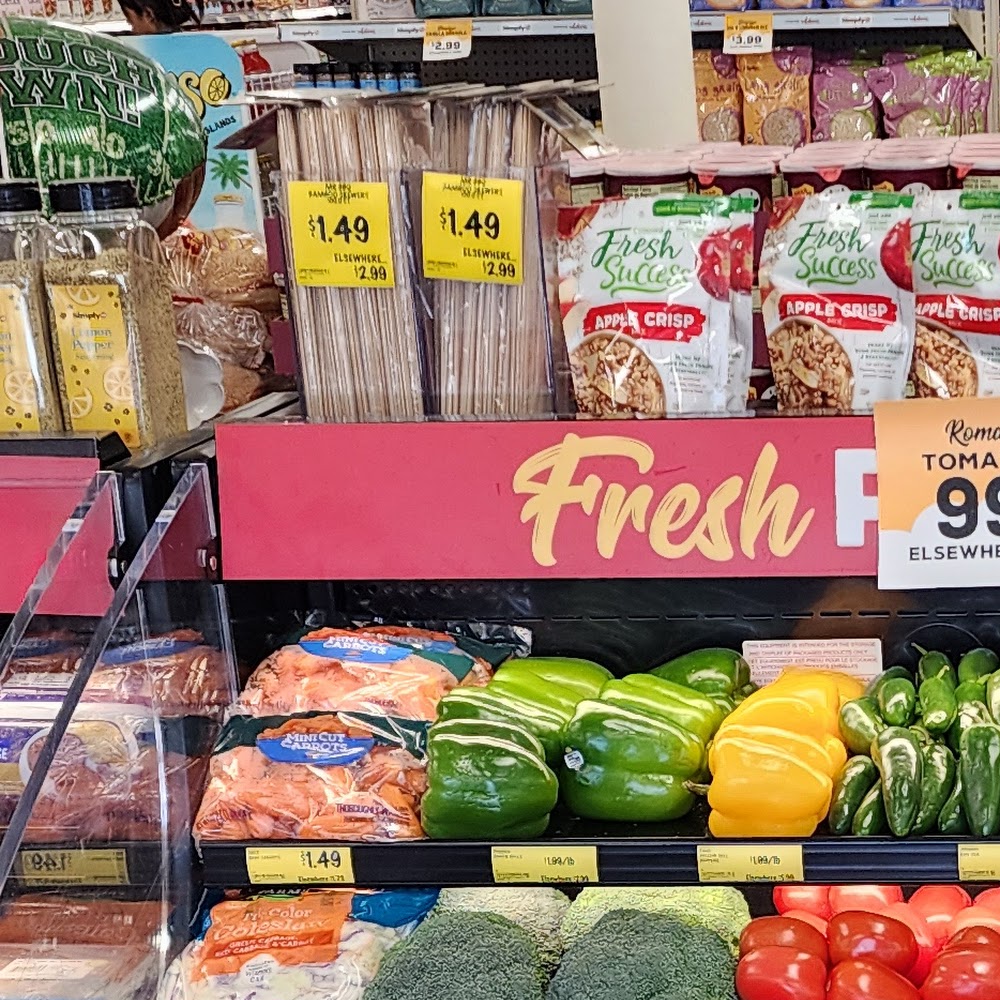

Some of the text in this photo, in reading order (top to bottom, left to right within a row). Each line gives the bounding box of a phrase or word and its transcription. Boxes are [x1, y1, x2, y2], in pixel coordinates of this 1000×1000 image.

[308, 214, 370, 244] $1.49
[439, 206, 500, 240] $1.49
[788, 220, 873, 260] Fresh
[591, 226, 683, 268] Fresh
[911, 220, 986, 262] Fresh
[600, 254, 692, 292] Success
[794, 246, 878, 282] Success
[920, 250, 997, 282] Success
[595, 307, 695, 333] APPLE CRISP
[786, 300, 889, 320] APPLE CRISP
[512, 432, 816, 567] Fresh
[300, 850, 342, 869] $1.49
